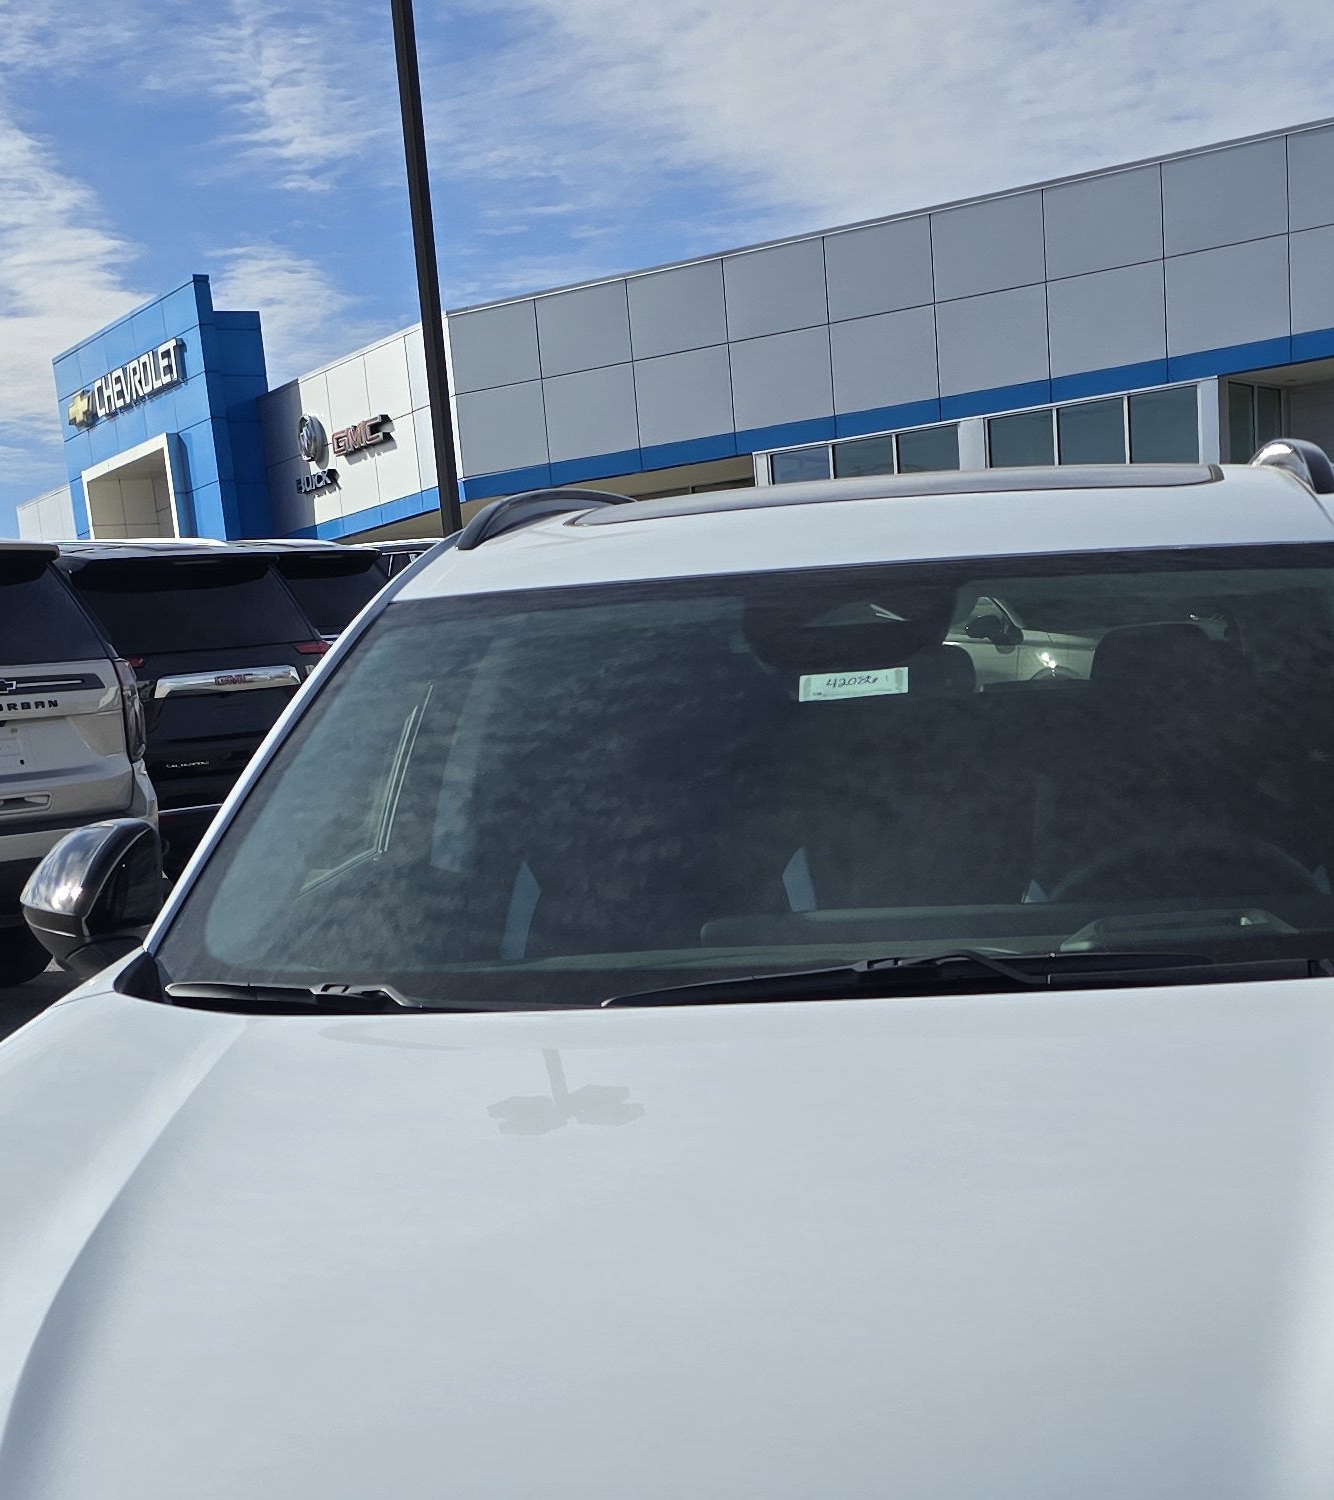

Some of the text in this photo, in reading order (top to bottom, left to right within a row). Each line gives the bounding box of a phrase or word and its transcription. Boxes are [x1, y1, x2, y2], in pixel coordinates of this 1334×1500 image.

[94, 338, 178, 418] CHEVROLET
[332, 415, 383, 457] GMC
[297, 470, 332, 494] BUICK
